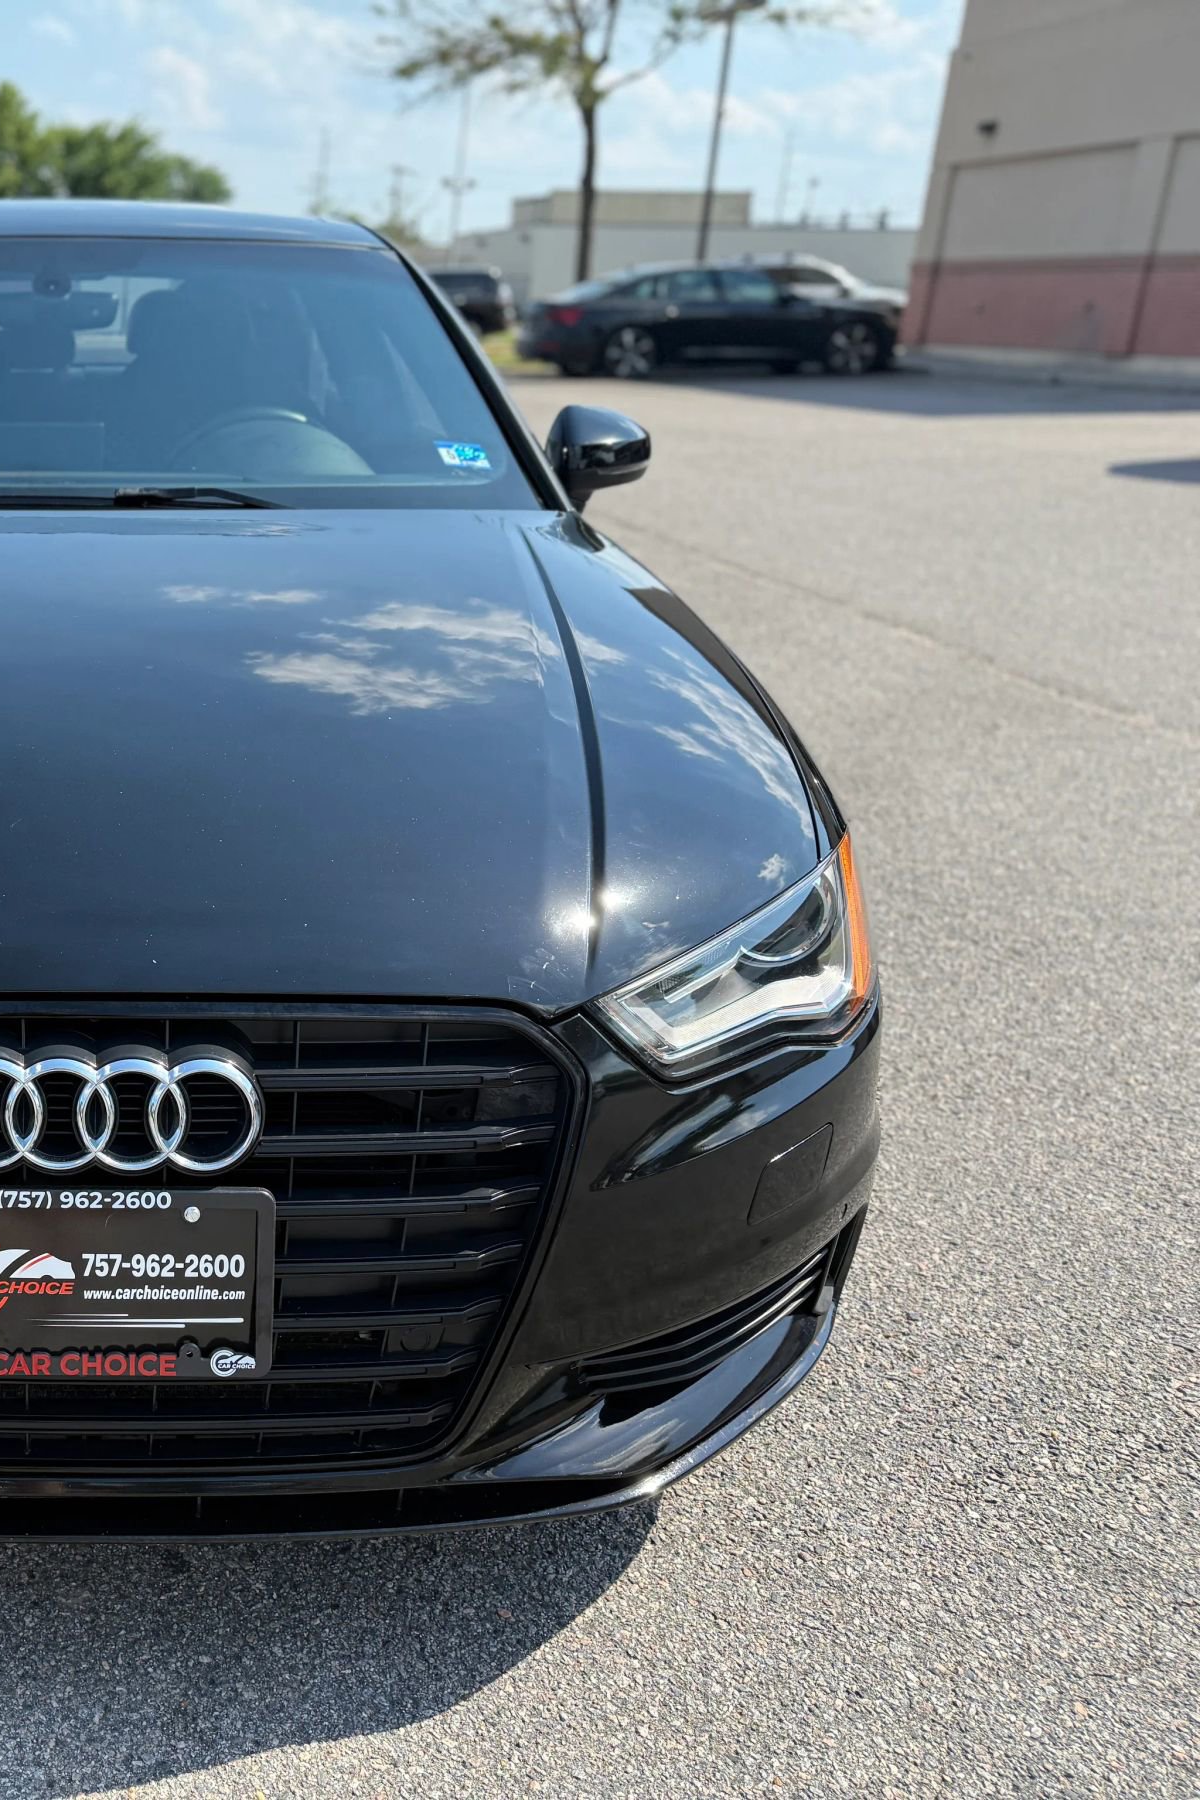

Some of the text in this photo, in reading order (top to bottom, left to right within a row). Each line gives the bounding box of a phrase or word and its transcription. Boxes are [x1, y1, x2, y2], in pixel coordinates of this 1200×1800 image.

[59, 1191, 172, 1209] 962-2600
[81, 1253, 245, 1278] 757-962-2600
[83, 1285, 245, 1300] www.carchoiceonline.com
[59, 1353, 177, 1377] CHOICE
